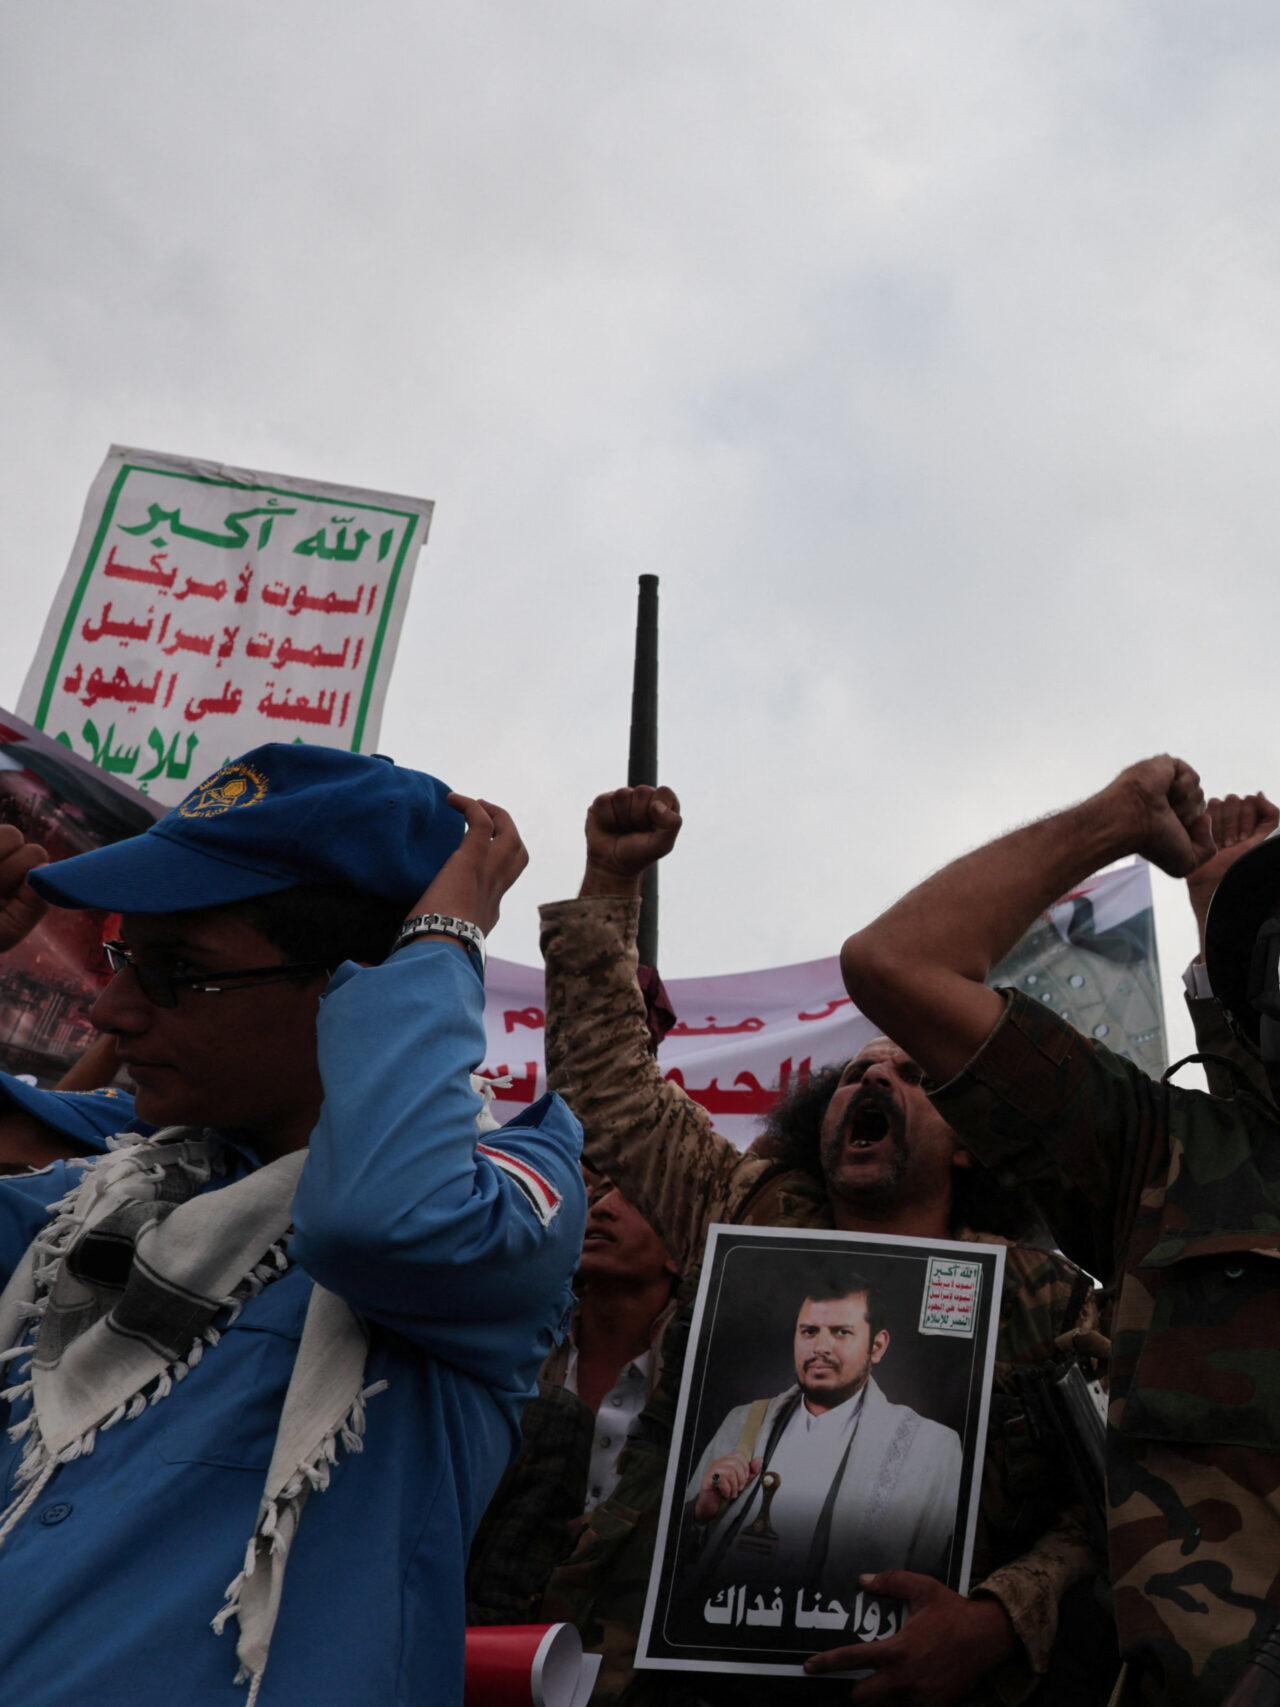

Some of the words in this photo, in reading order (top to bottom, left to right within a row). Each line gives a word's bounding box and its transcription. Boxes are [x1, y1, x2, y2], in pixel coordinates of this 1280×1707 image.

[117, 499, 298, 550] أكبر
[293, 515, 394, 563] الله
[103, 545, 254, 603] لأمريكا
[260, 581, 377, 616] الموت
[82, 601, 239, 667] لإسرائيل
[246, 632, 364, 670] الموت
[63, 663, 178, 712] اليهود
[184, 680, 243, 721] على
[257, 682, 351, 727] اللعنة
[704, 1584, 784, 1627] فداك
